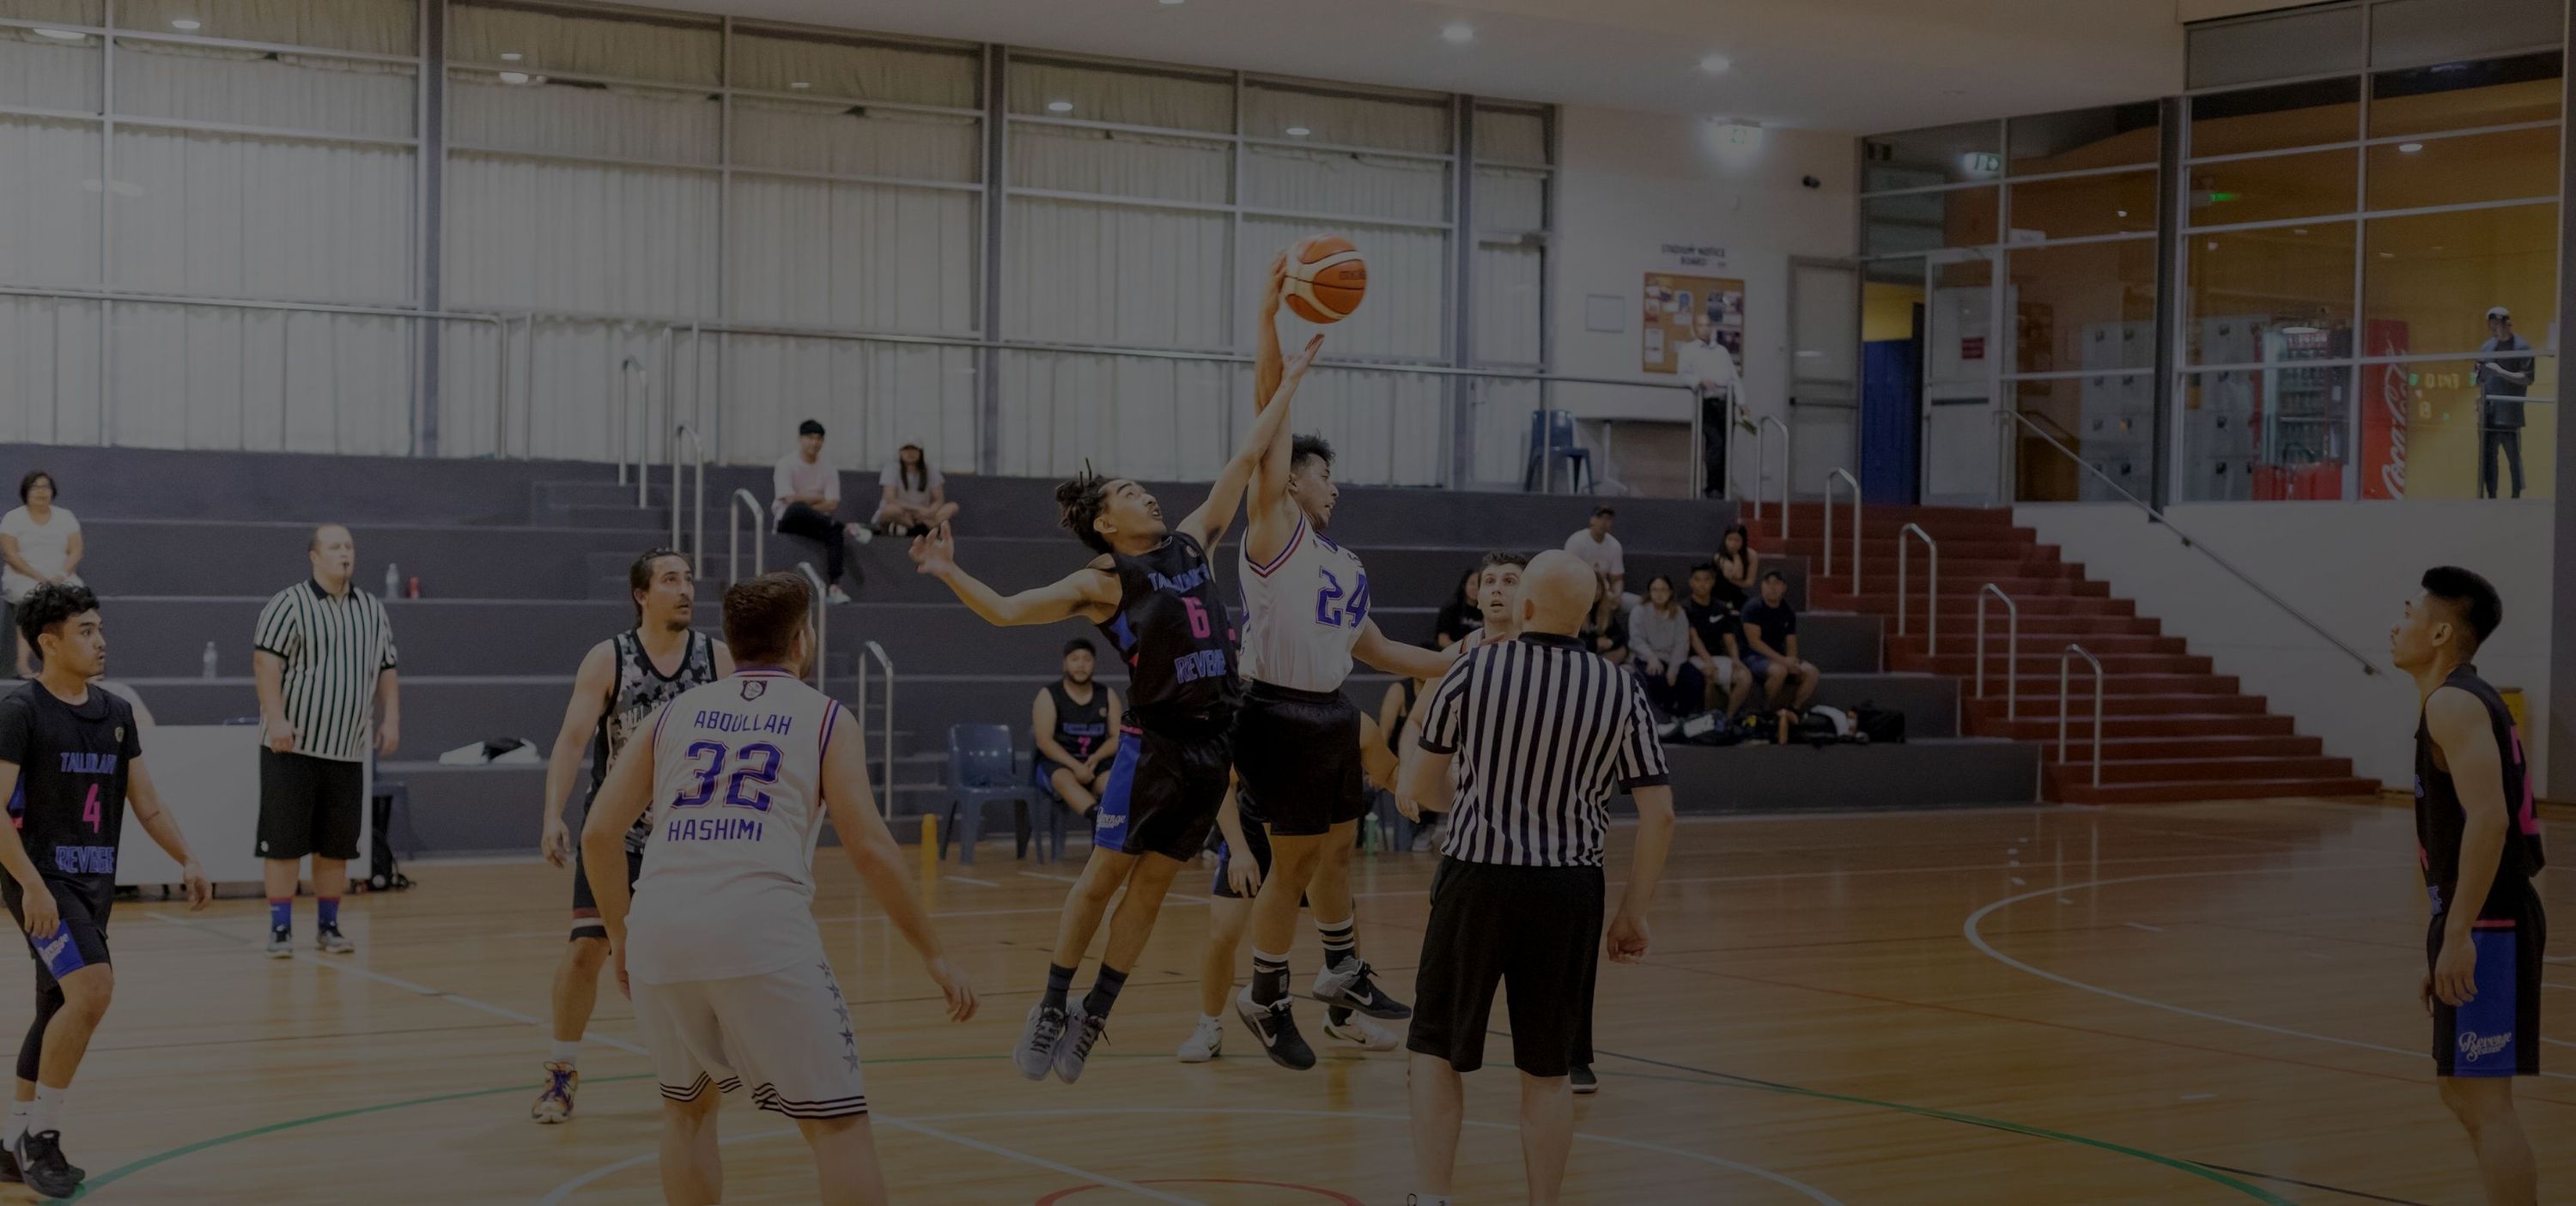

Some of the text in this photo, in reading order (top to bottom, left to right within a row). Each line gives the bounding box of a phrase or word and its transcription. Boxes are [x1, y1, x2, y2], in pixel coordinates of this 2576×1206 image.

[1182, 597, 1211, 639] 6
[1315, 565, 1370, 631] 24
[694, 710, 793, 736] ABDULLAH
[670, 739, 784, 814] 32
[82, 783, 101, 834] 4
[667, 819, 763, 842] HASHIMI
